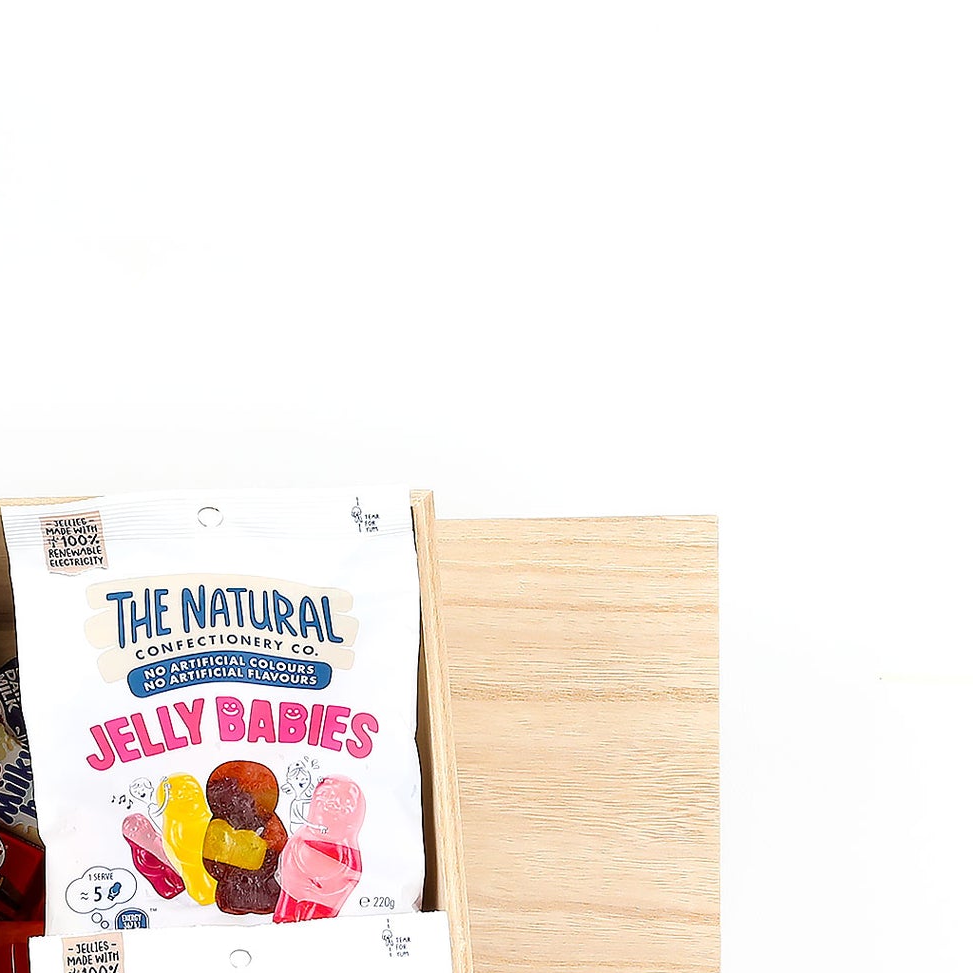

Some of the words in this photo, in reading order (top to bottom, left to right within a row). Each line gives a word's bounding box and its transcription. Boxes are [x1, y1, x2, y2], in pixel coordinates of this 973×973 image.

[53, 518, 87, 527] JELLIES
[46, 527, 71, 536] MADE
[73, 525, 98, 534] WITH
[62, 534, 100, 548] 100%
[48, 545, 102, 558] RENEWABLE
[49, 556, 104, 567] ELECTRICITY
[106, 588, 172, 649] THE
[181, 584, 344, 643] NATURAL
[135, 634, 283, 660] CONFECTIONERY
[291, 644, 319, 657] CO.
[143, 665, 166, 680] NO
[169, 655, 246, 675] ARTIFICIAL
[249, 656, 315, 675] COLOURS
[143, 678, 167, 692] NO
[169, 668, 244, 687] ARTIFICIAL
[247, 669, 317, 686] FLAVOURS
[86, 698, 204, 771] JELLY
[215, 696, 379, 759] BABIES
[93, 872, 114, 881] SERVE
[93, 885, 102, 902] 5
[373, 896, 395, 910] 220g
[75, 941, 109, 954] JELLIES
[67, 954, 93, 966] MADE
[95, 951, 120, 964] WITH
